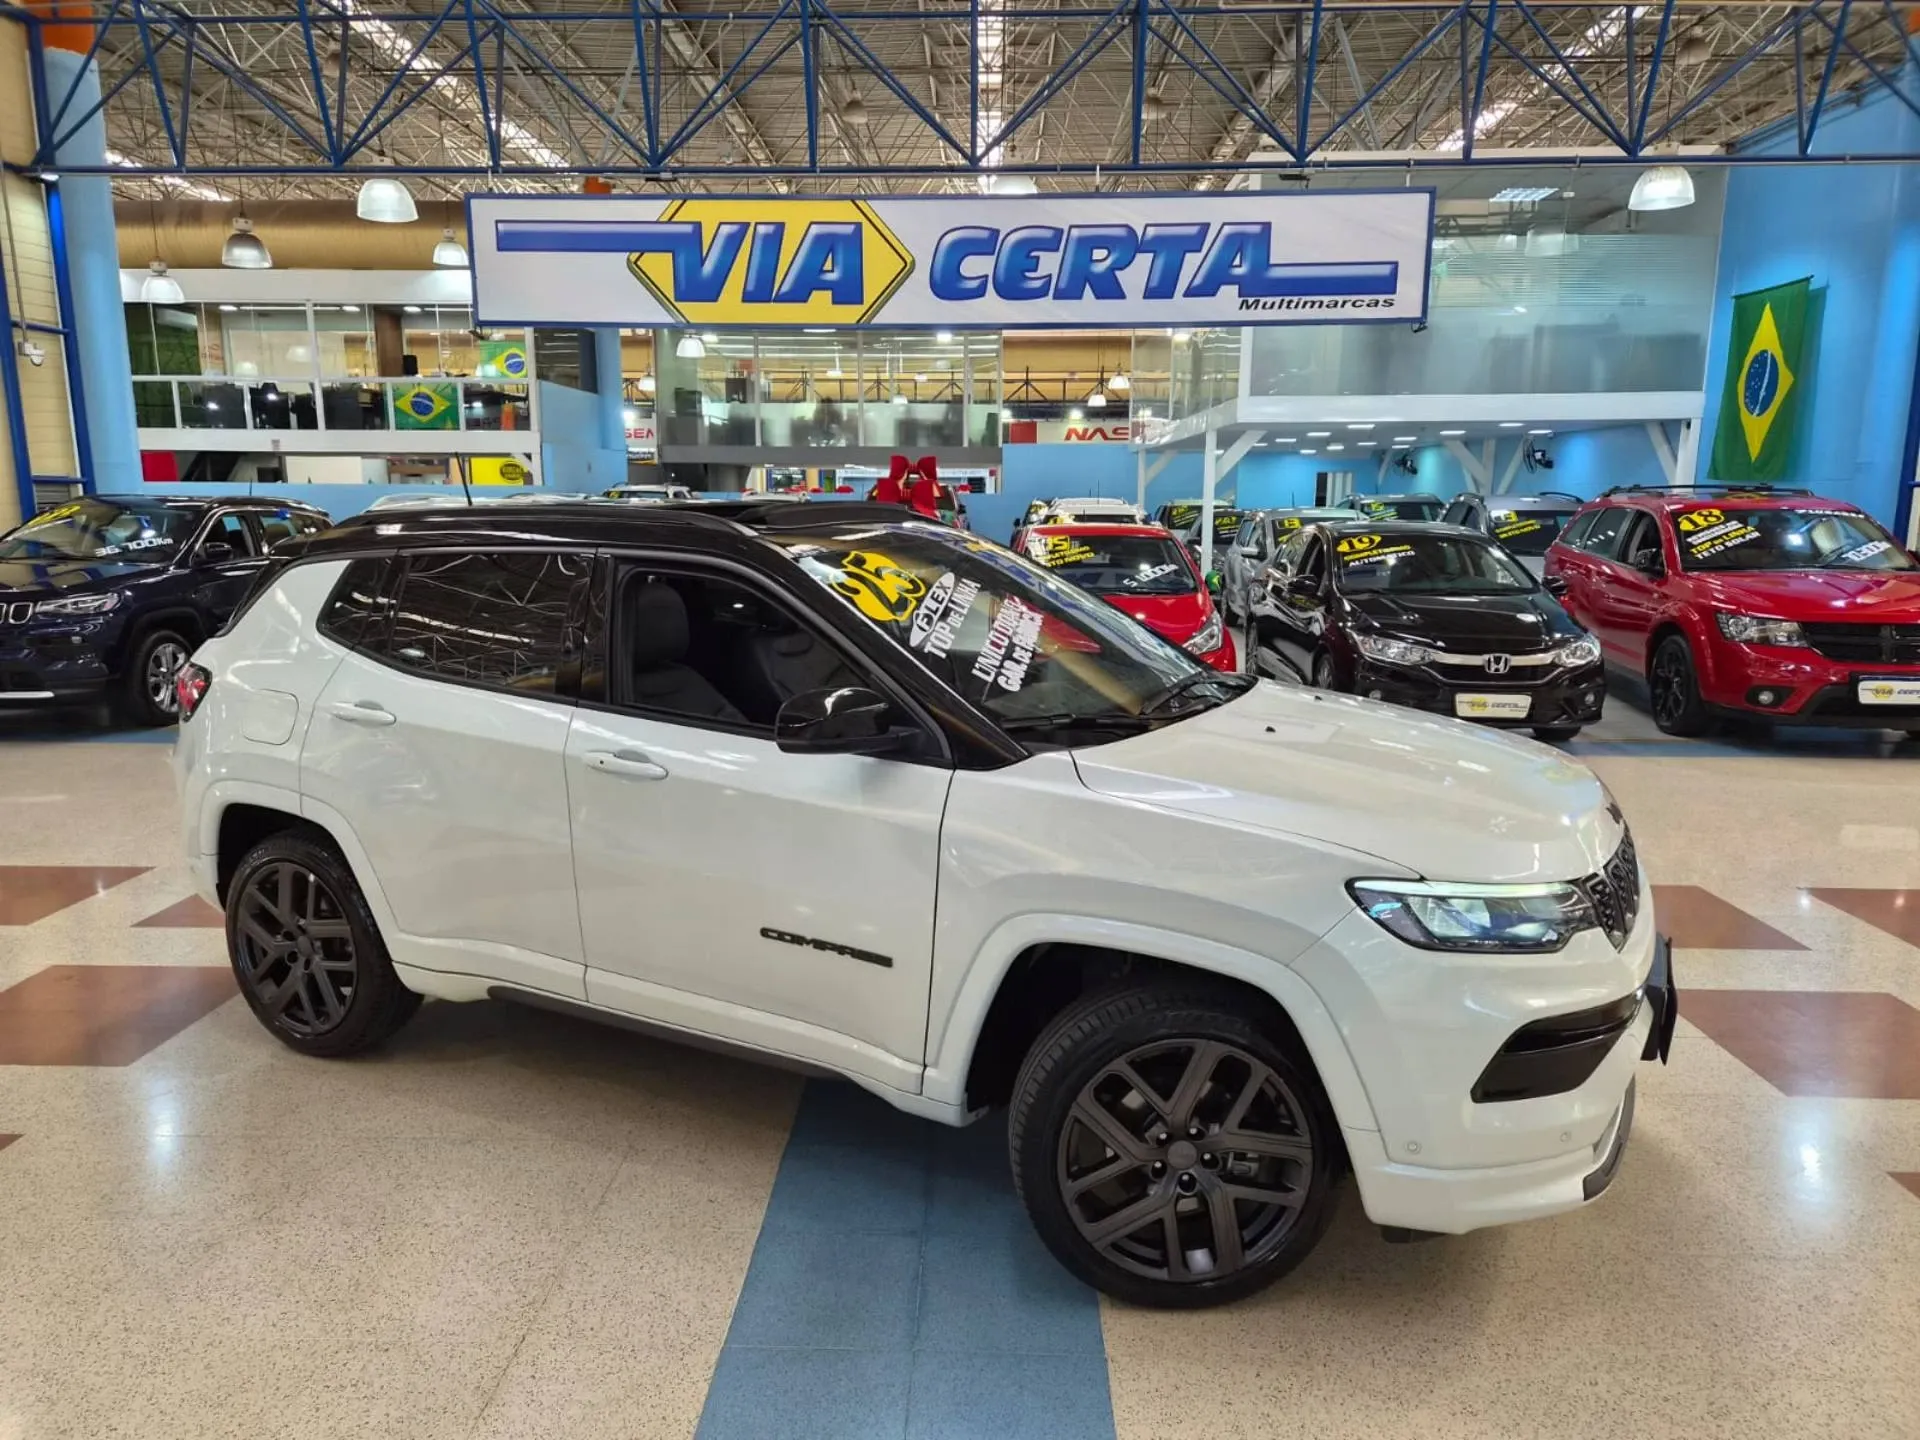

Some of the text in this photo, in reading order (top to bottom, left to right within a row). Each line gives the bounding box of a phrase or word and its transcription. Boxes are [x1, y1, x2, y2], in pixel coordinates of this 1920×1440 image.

[673, 222, 1272, 305] VIA CERTA
[1238, 296, 1395, 311] Multimarcas
[1681, 509, 1723, 530] 18
[1339, 534, 1379, 551] 19
[1689, 540, 1712, 555] TOP
[1695, 544, 1725, 559] TETO
[1724, 531, 1761, 548] SOLAR
[831, 550, 926, 622] 25
[915, 580, 952, 632] FLEX
[923, 577, 981, 659] TOP DE LINHA
